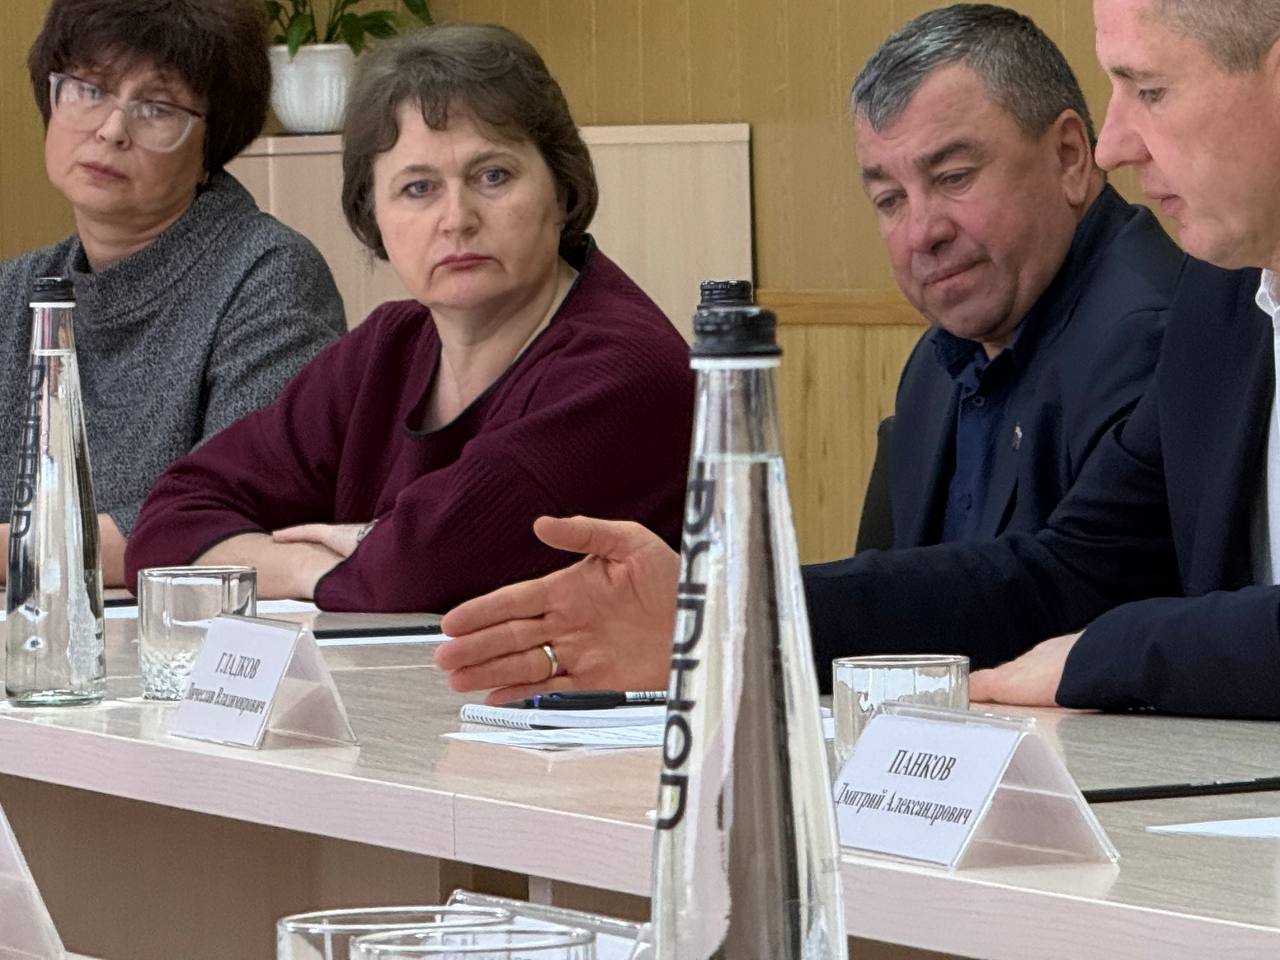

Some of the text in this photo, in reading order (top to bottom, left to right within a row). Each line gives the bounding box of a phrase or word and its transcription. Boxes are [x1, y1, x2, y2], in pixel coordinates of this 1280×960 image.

[887, 749, 957, 782] ПАНКОВ
[833, 782, 973, 826] Дмитрий Александрович
